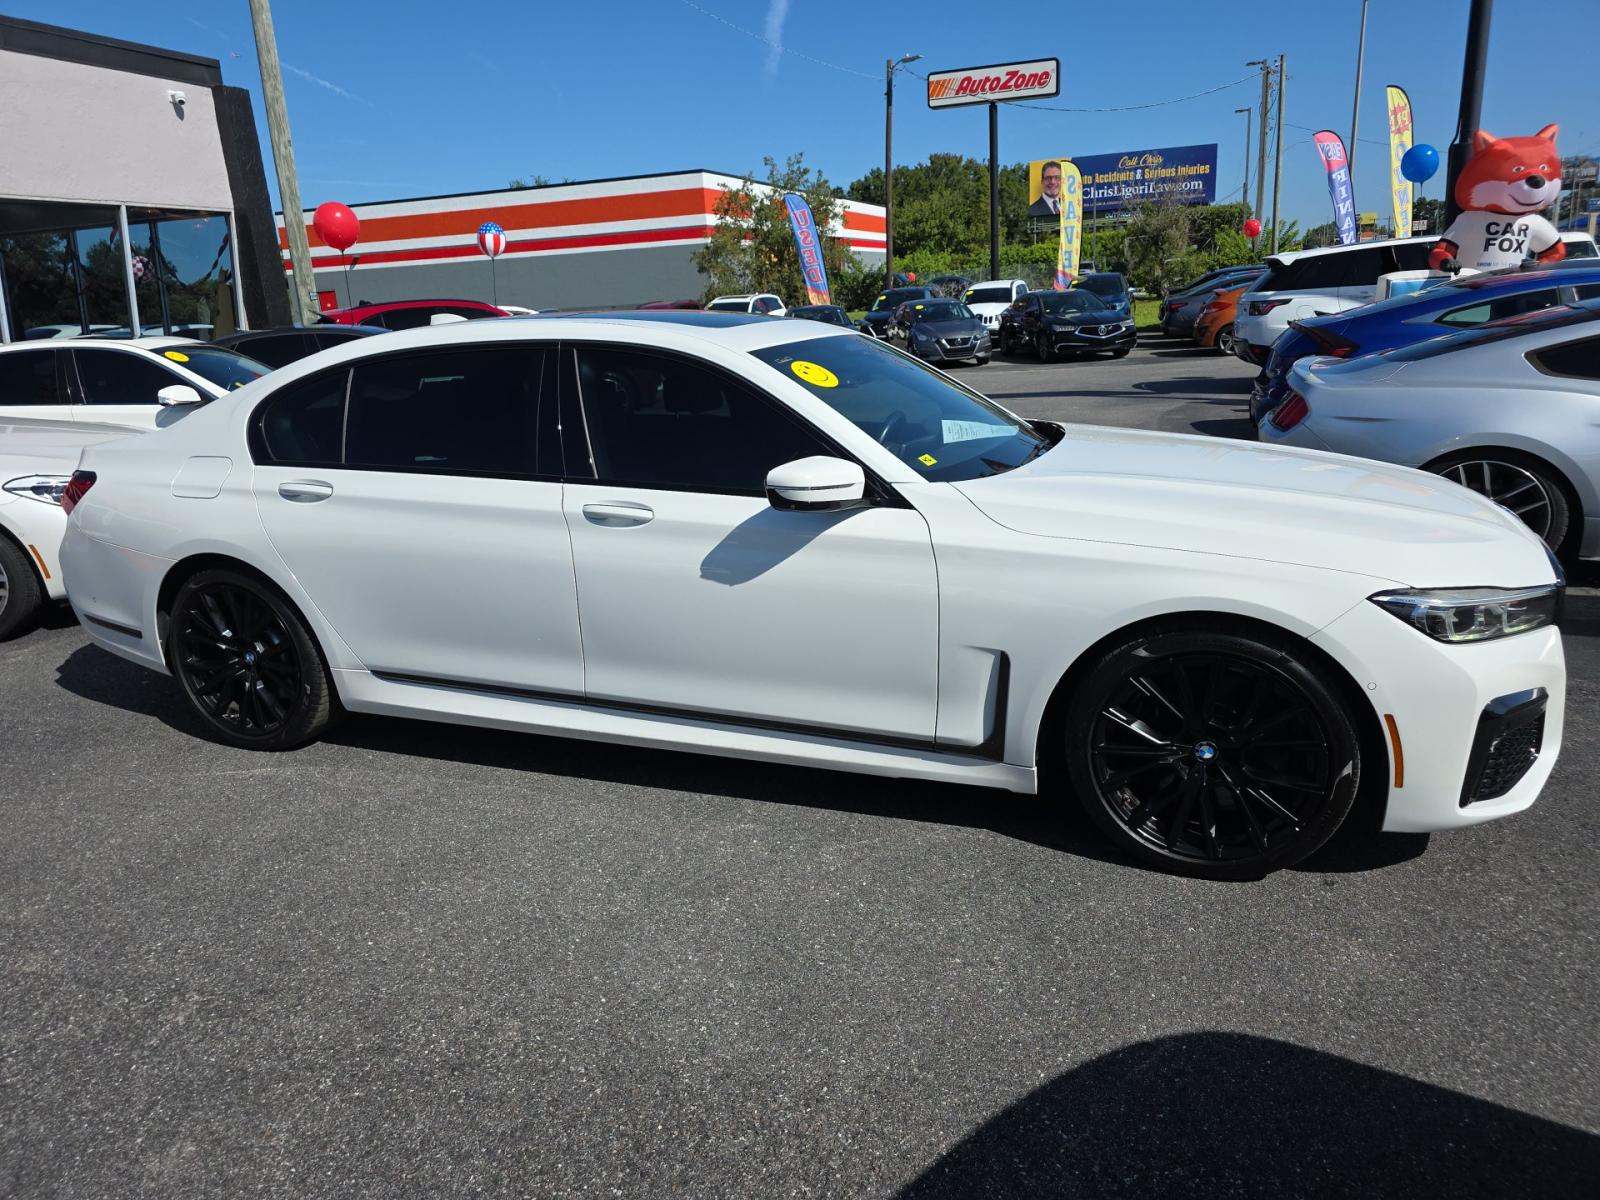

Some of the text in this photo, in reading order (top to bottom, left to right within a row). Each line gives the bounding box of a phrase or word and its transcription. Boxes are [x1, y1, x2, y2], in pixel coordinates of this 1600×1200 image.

[955, 70, 1051, 96] AutoZone
[1118, 155, 1138, 168] Call
[1095, 170, 1134, 184] Accidents
[1135, 168, 1143, 180] &
[1144, 166, 1176, 180] Serious
[1178, 163, 1210, 176] Injuries
[1485, 221, 1530, 238] CAR
[1483, 237, 1526, 254] FOX
